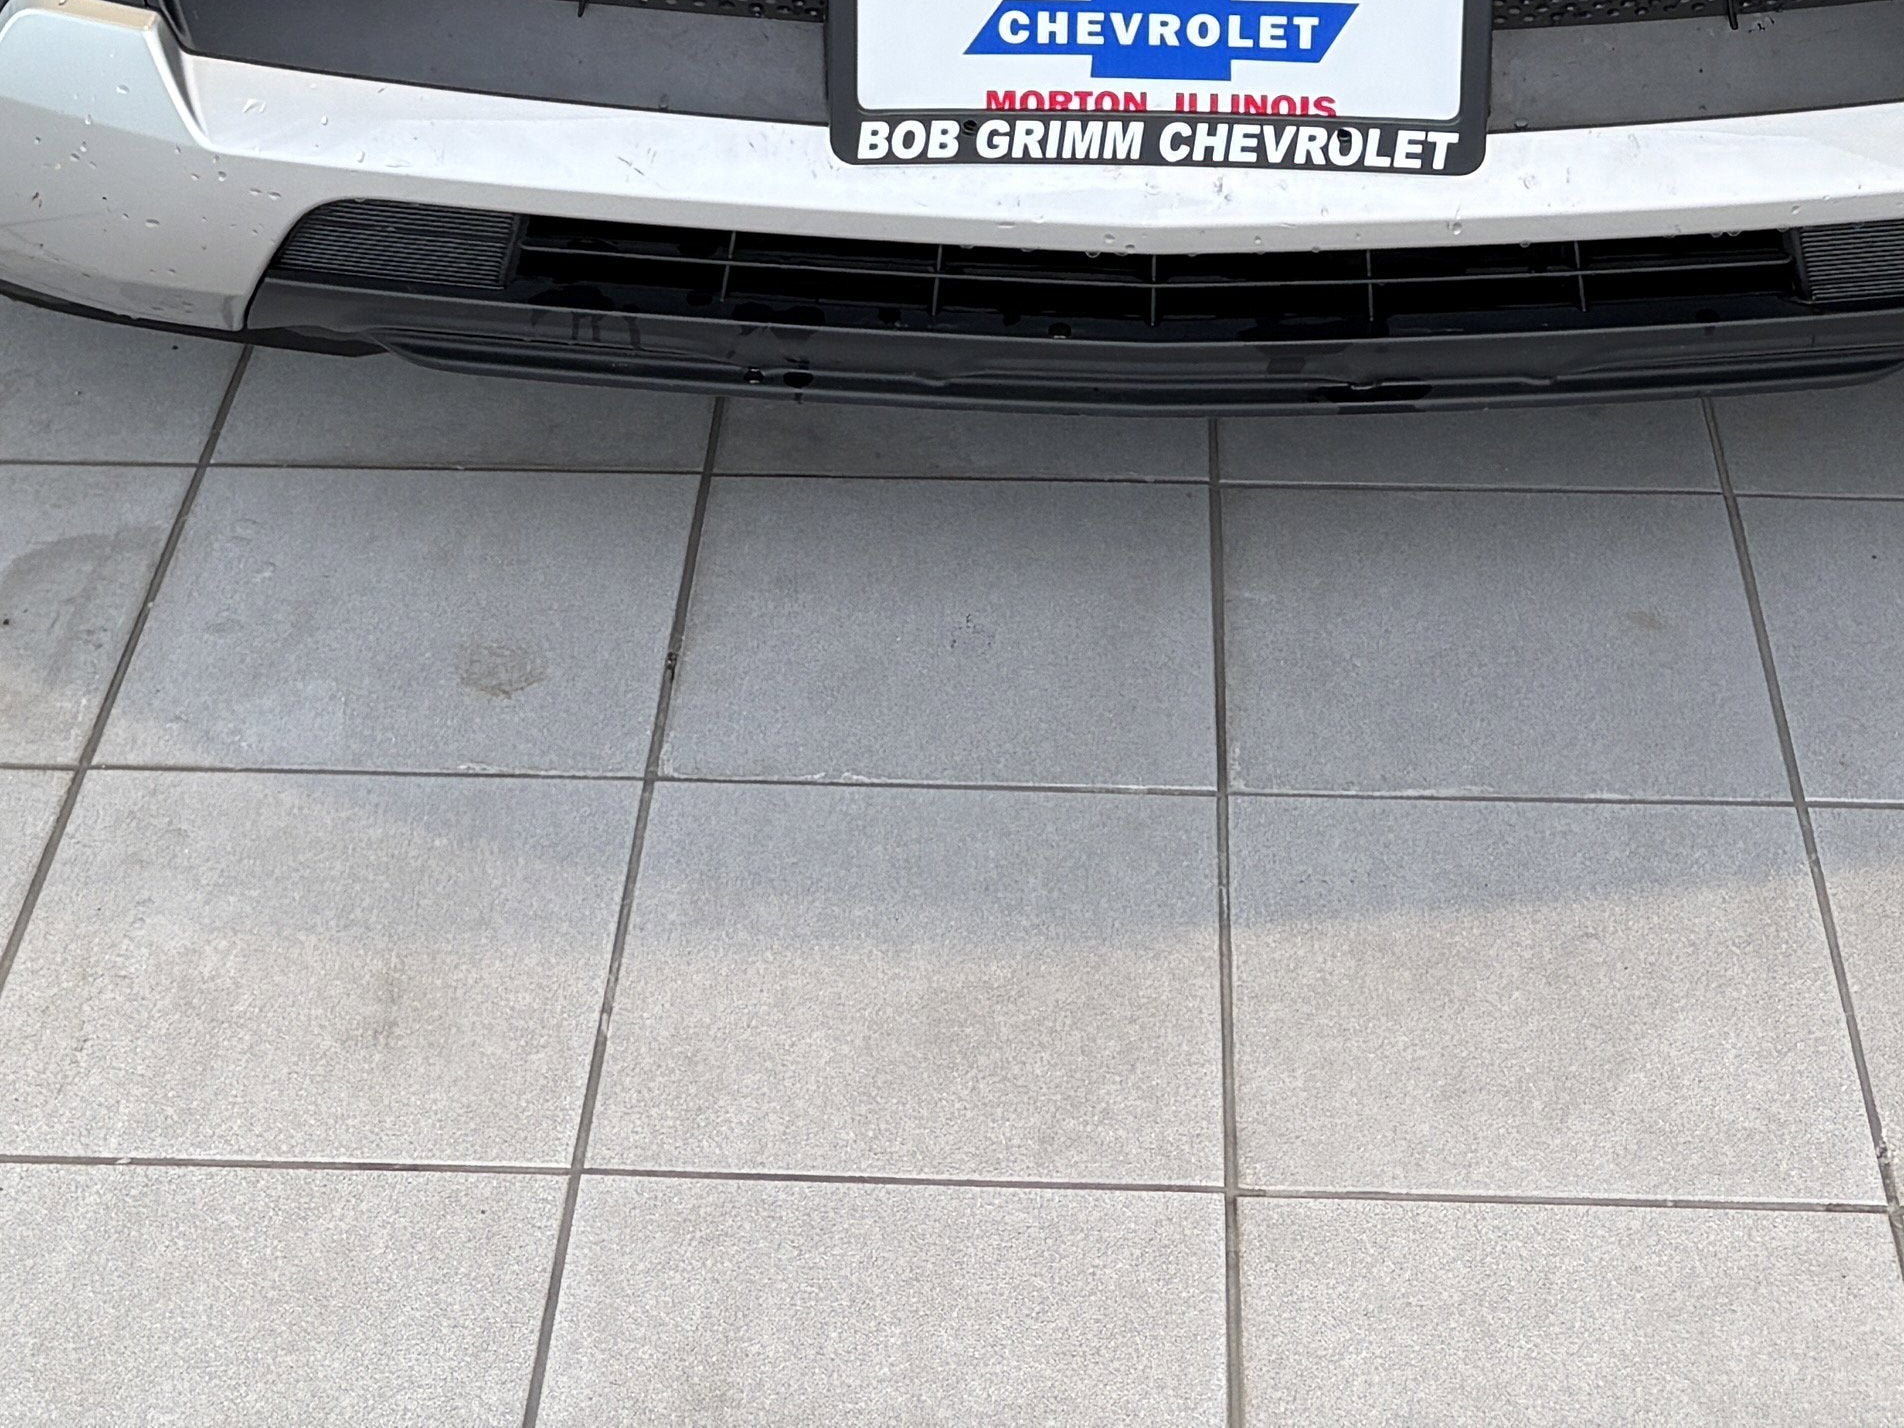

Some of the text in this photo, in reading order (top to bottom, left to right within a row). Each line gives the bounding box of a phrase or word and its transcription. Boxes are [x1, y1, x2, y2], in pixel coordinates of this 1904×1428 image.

[998, 10, 1320, 50] CHEVROLET
[986, 90, 1147, 112] MORTON
[857, 119, 1460, 170] BOB GRIMM CHEVROLET
